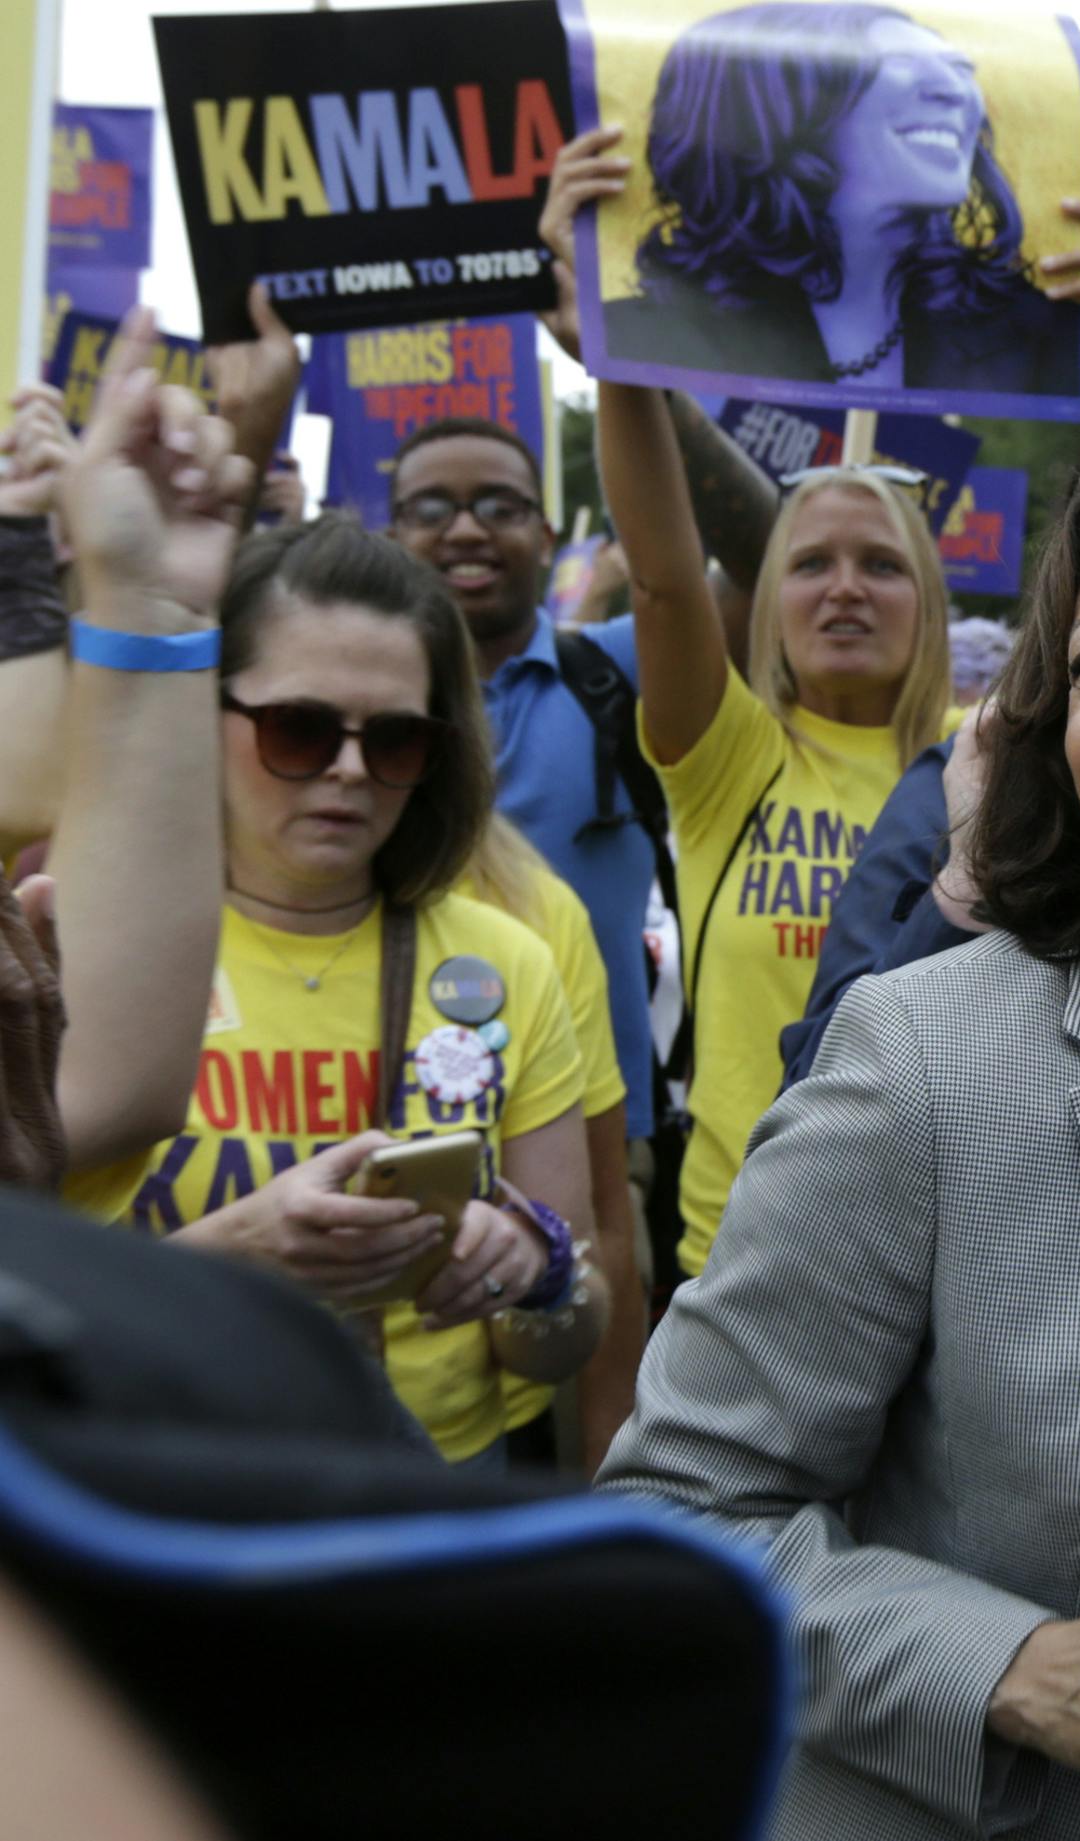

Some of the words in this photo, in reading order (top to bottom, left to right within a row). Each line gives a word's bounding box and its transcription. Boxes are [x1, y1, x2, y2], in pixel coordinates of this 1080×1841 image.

[194, 79, 566, 225] KAMALA
[257, 269, 328, 300] TEXT
[333, 260, 412, 294] IOWA
[413, 257, 454, 286] TO
[346, 324, 453, 388] HARRIS
[453, 322, 512, 380] FOR
[193, 1049, 381, 1135] OMEN
